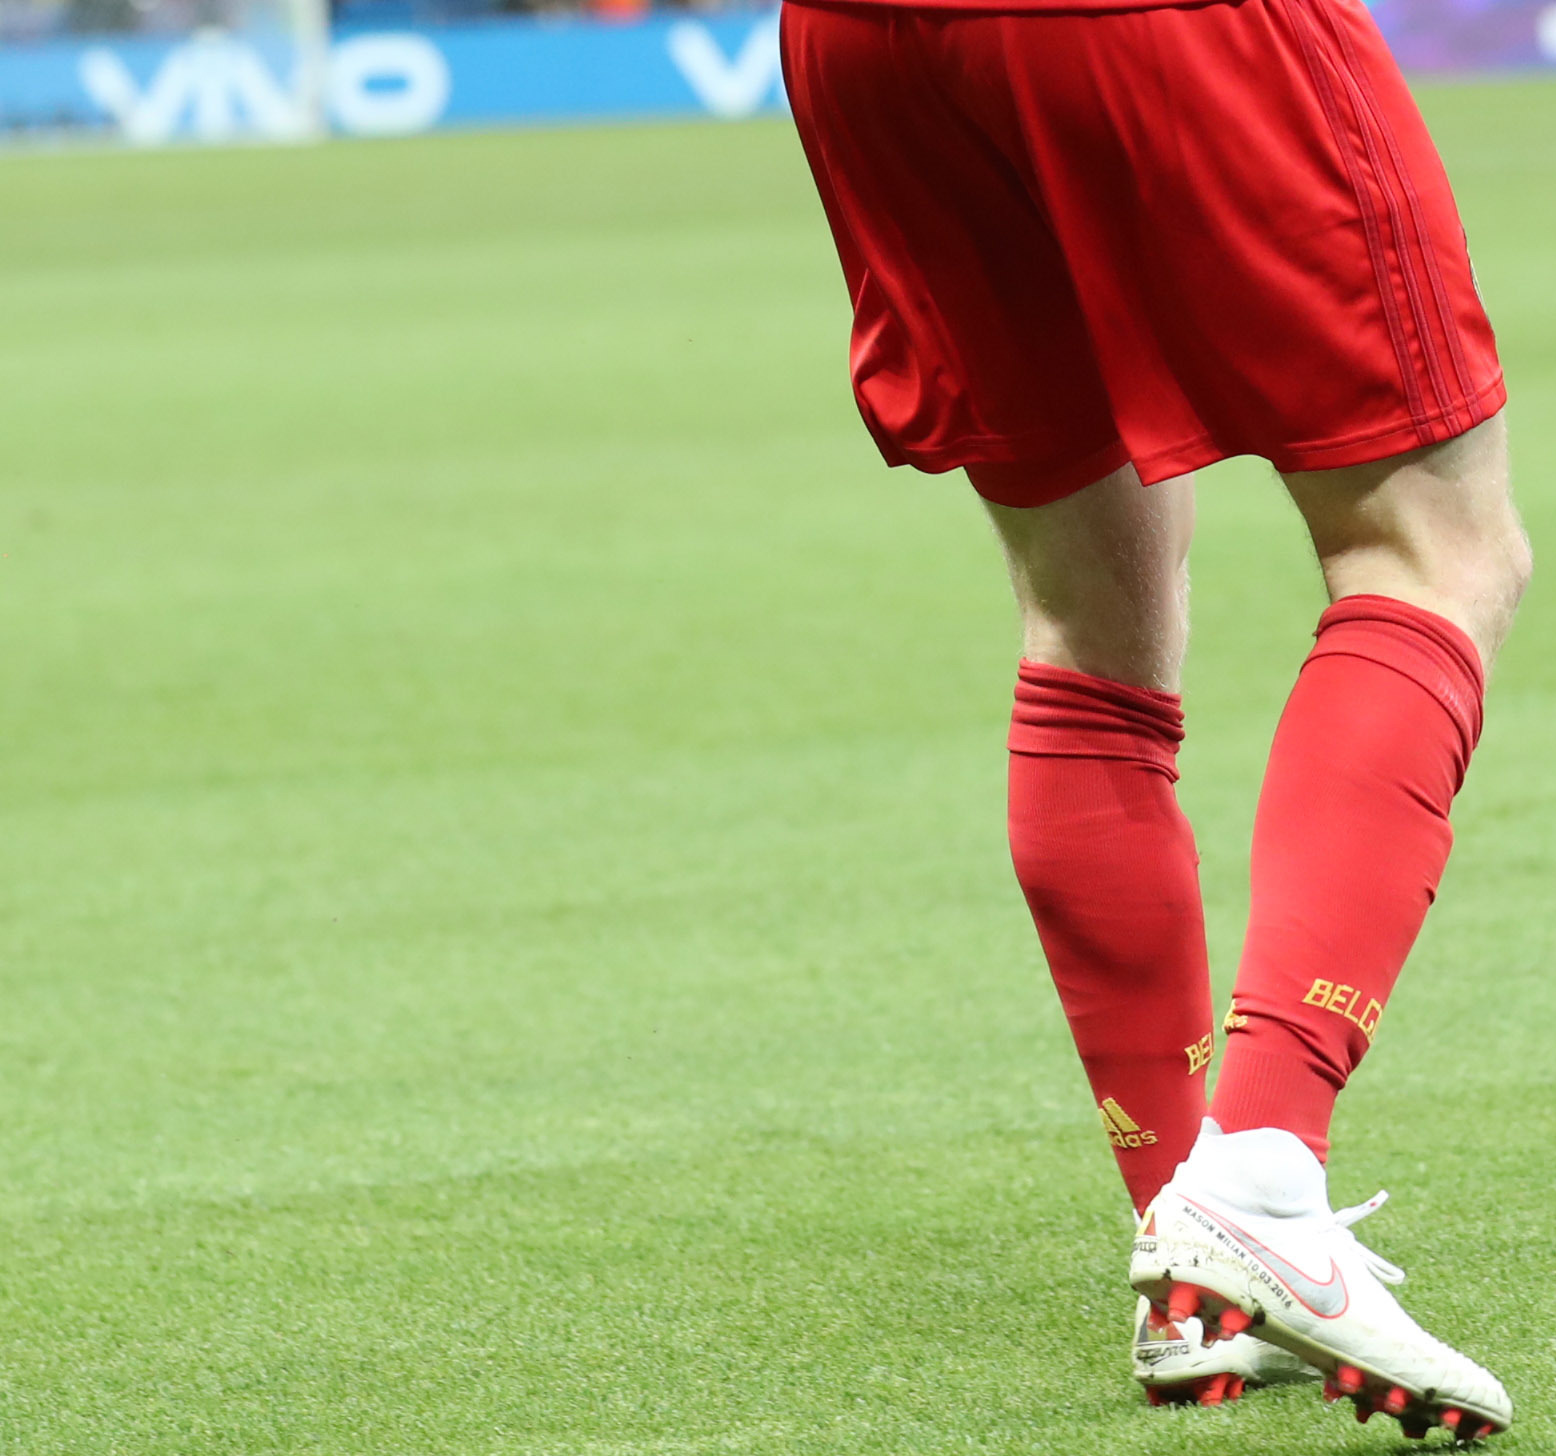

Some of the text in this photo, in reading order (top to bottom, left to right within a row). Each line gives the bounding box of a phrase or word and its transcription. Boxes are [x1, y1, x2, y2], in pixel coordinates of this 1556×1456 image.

[1182, 1205, 1294, 1310] MASON MILIAN 10.03.2016
